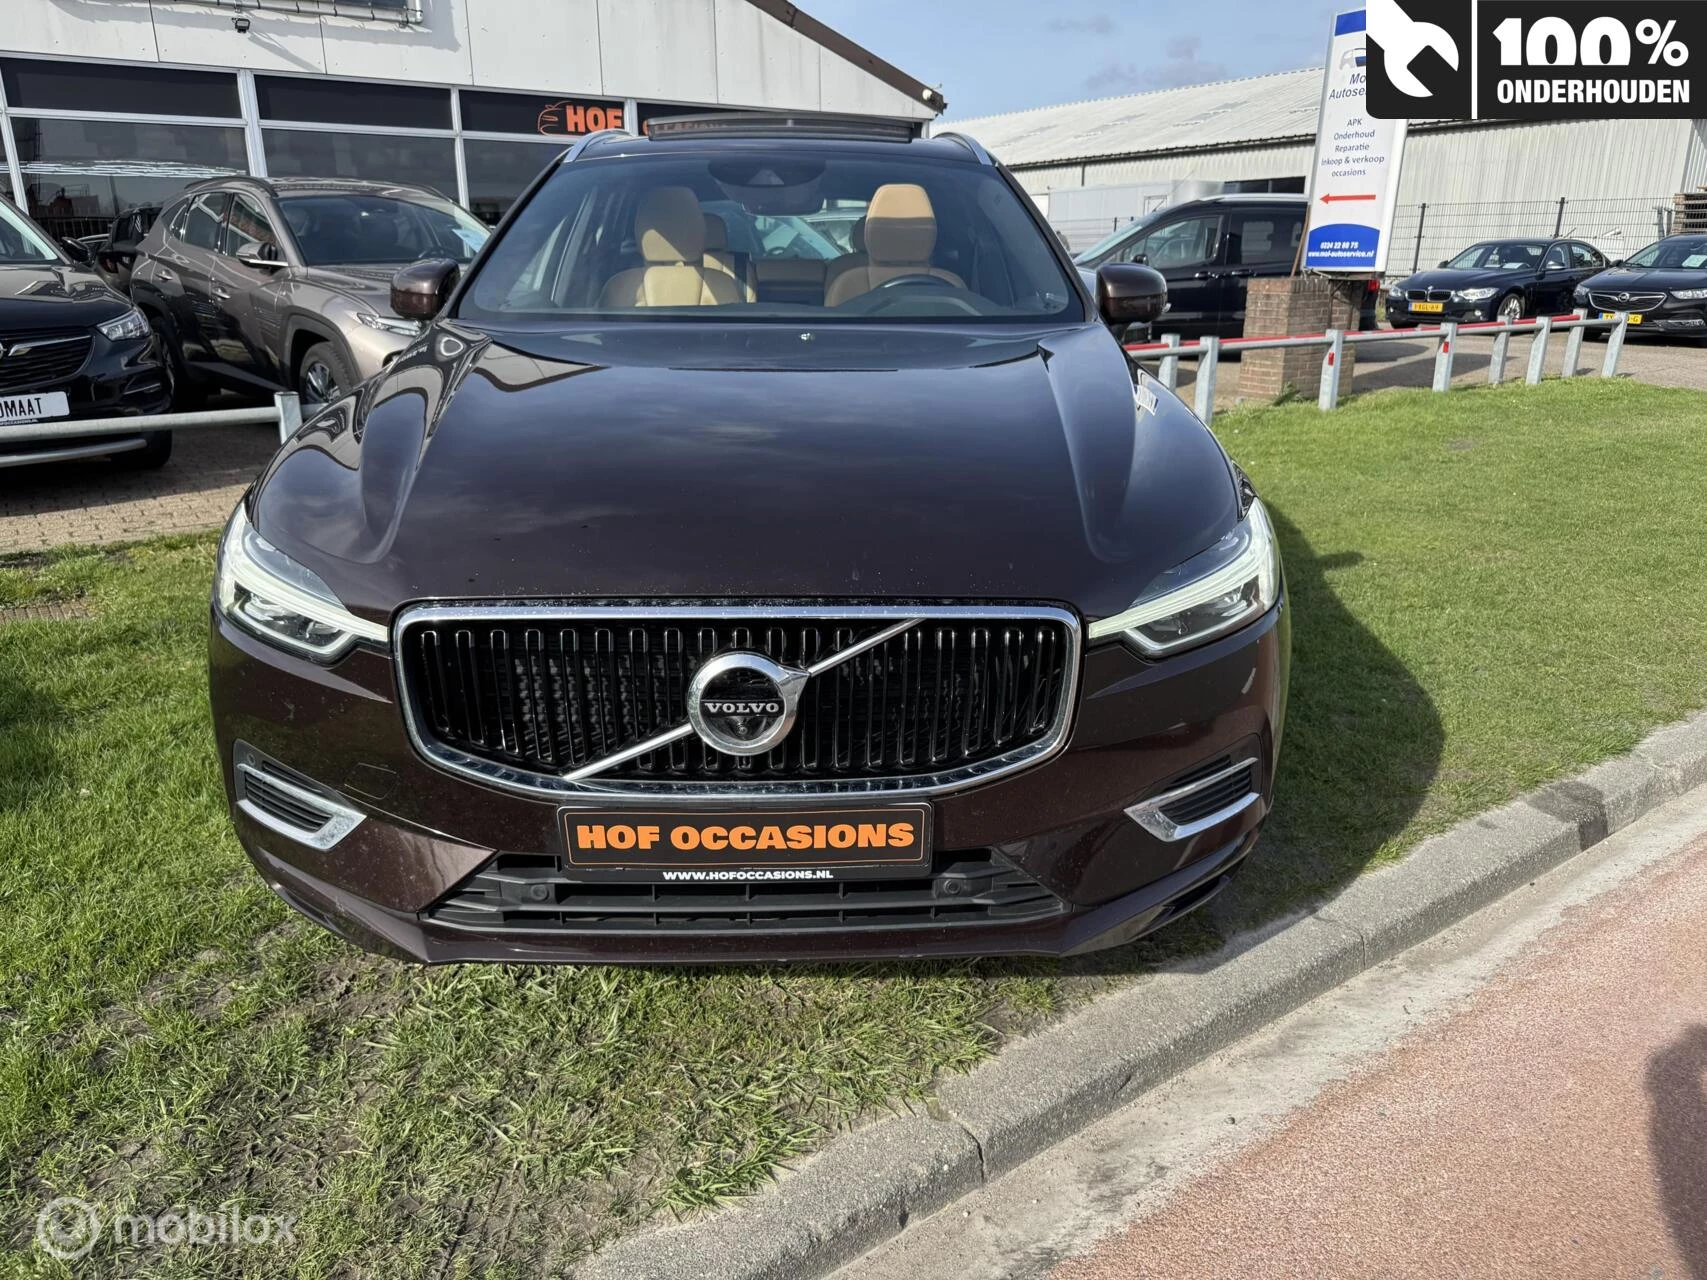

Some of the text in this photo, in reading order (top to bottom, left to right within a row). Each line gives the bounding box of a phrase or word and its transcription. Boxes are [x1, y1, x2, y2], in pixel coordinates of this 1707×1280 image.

[565, 105, 623, 133] HOF
[1347, 118, 1362, 127] APK
[1333, 130, 1376, 140] Onderhoud
[1334, 143, 1370, 153] Reparatie
[1321, 155, 1385, 166] Inkoop & verkoop
[1331, 168, 1366, 177] occasions
[704, 701, 780, 714] VOLVO
[576, 822, 915, 850] HOF OCCASIONS
[663, 870, 833, 881] WWW.HOFOCCASIONS.NL
